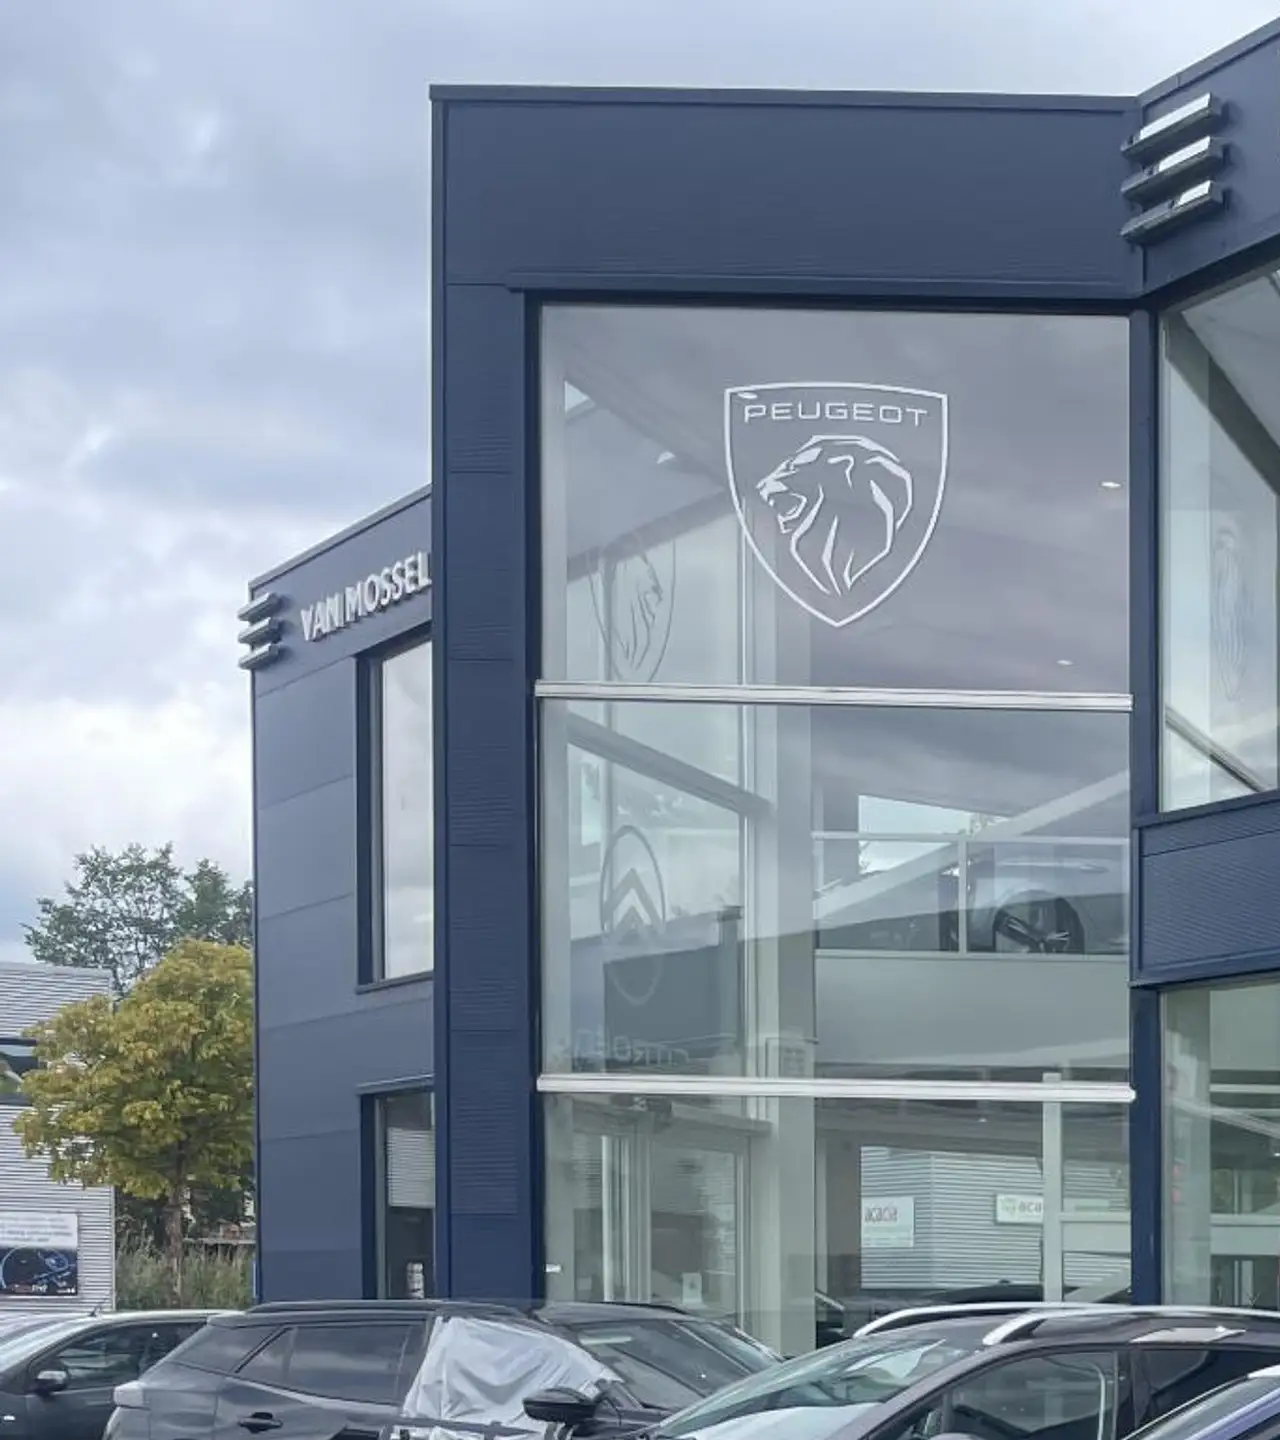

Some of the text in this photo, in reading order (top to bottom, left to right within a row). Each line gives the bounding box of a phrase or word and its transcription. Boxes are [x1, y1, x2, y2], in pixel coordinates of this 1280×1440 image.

[744, 401, 928, 427] PEUGEOT
[301, 551, 431, 641] VAN MOSSEL
